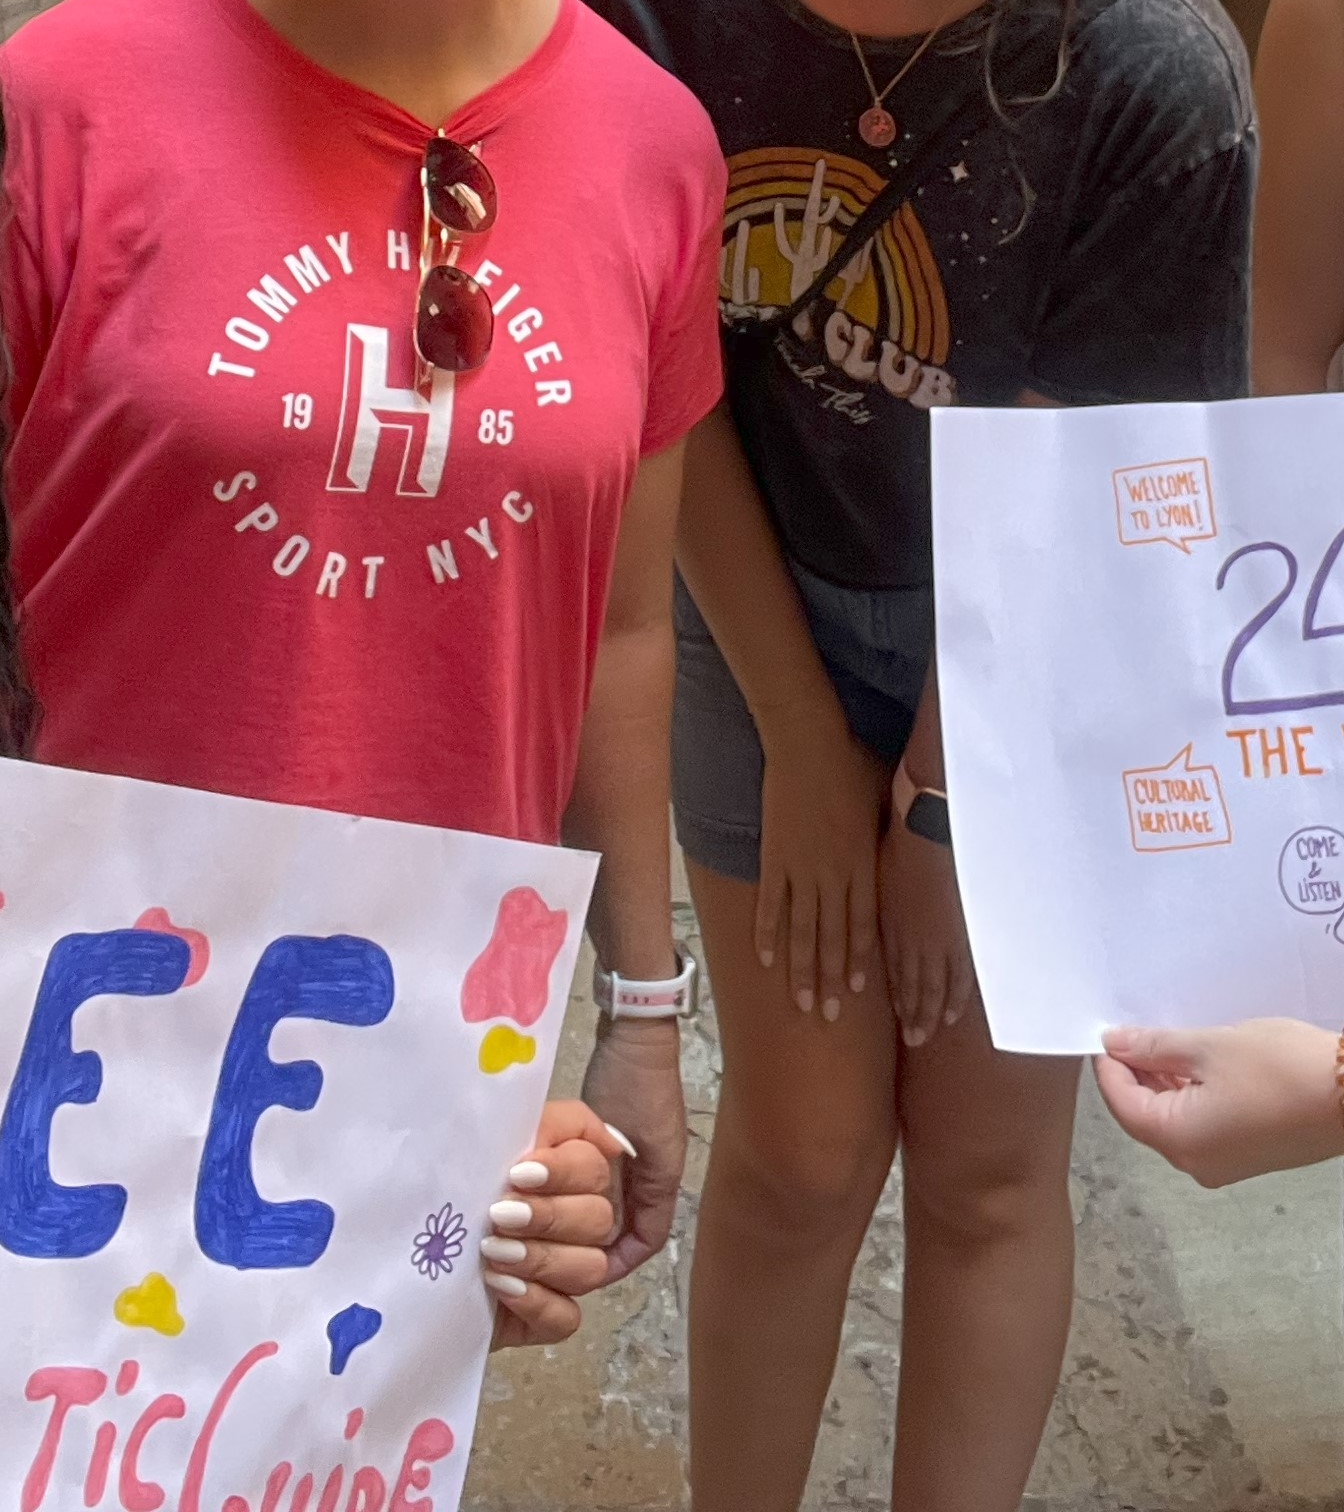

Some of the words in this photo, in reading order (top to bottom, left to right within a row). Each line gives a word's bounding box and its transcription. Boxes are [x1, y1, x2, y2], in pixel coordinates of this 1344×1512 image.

[208, 231, 353, 377] TOMMY
[386, 229, 572, 406] HFIGER
[282, 392, 312, 429] 19
[478, 408, 513, 445] 85
[1123, 471, 1200, 502] WELCOME
[1131, 510, 1150, 530] TO
[1157, 499, 1203, 531] LYON!
[213, 471, 384, 598] SPORT
[426, 491, 533, 584] NYC
[1225, 726, 1324, 779] THE
[1134, 778, 1212, 804] CULTURAL
[1137, 809, 1213, 833] HERITAGE
[1296, 836, 1340, 860] COME
[1298, 877, 1342, 902] LISTEN
